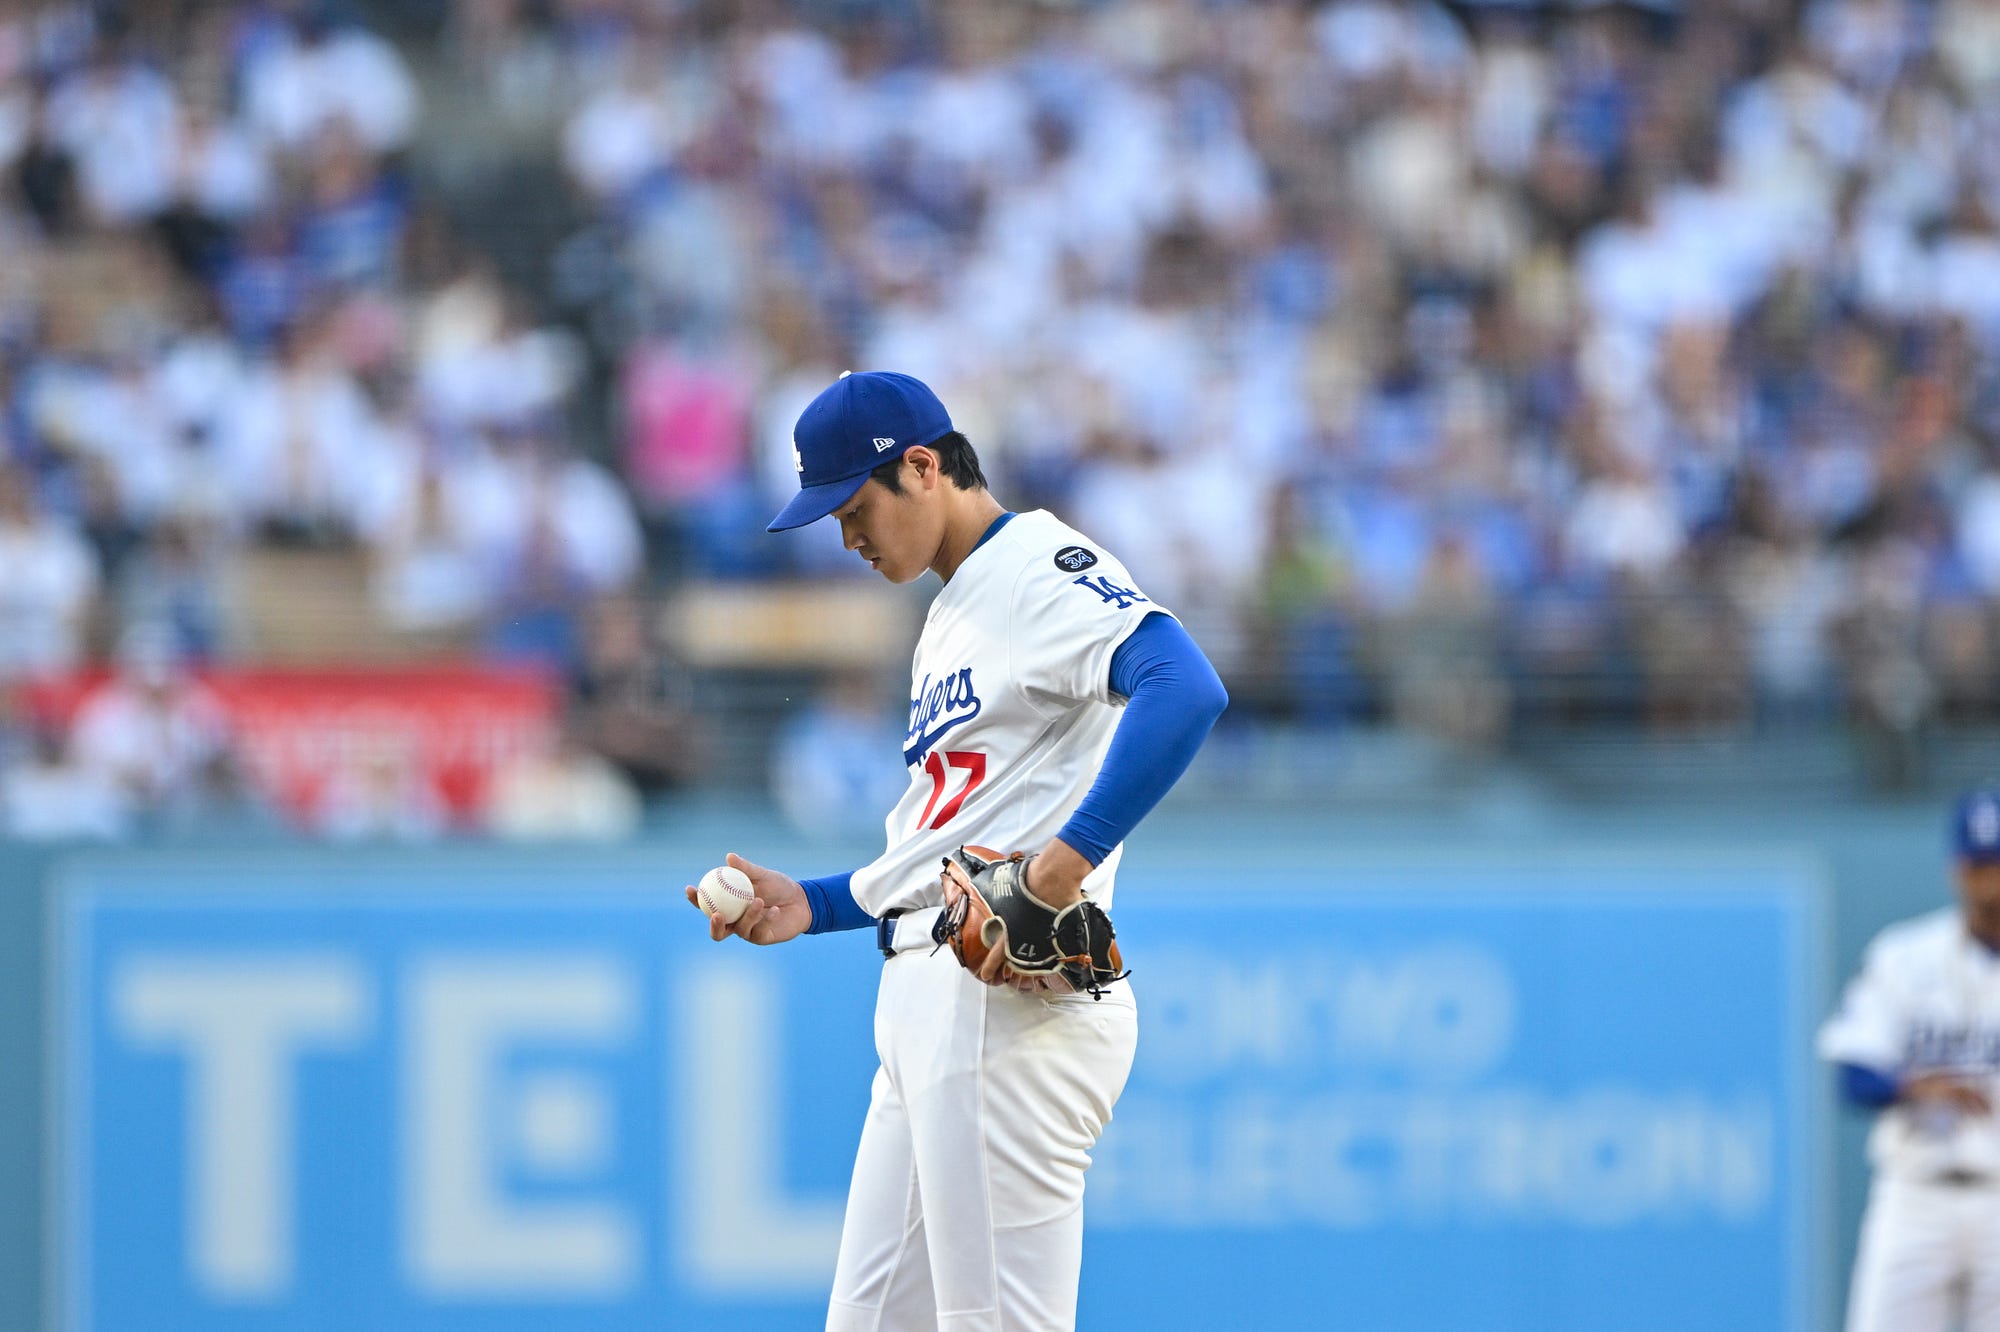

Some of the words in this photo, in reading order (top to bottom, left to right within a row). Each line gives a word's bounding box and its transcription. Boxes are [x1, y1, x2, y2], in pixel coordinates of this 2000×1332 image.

[1064, 552, 1094, 569] 34
[1072, 575, 1149, 609] LA
[904, 667, 981, 767] dgers
[916, 751, 987, 830] 17
[1016, 943, 1037, 957] 17
[1128, 945, 1518, 1082] OKYO
[112, 950, 846, 1298] TEL
